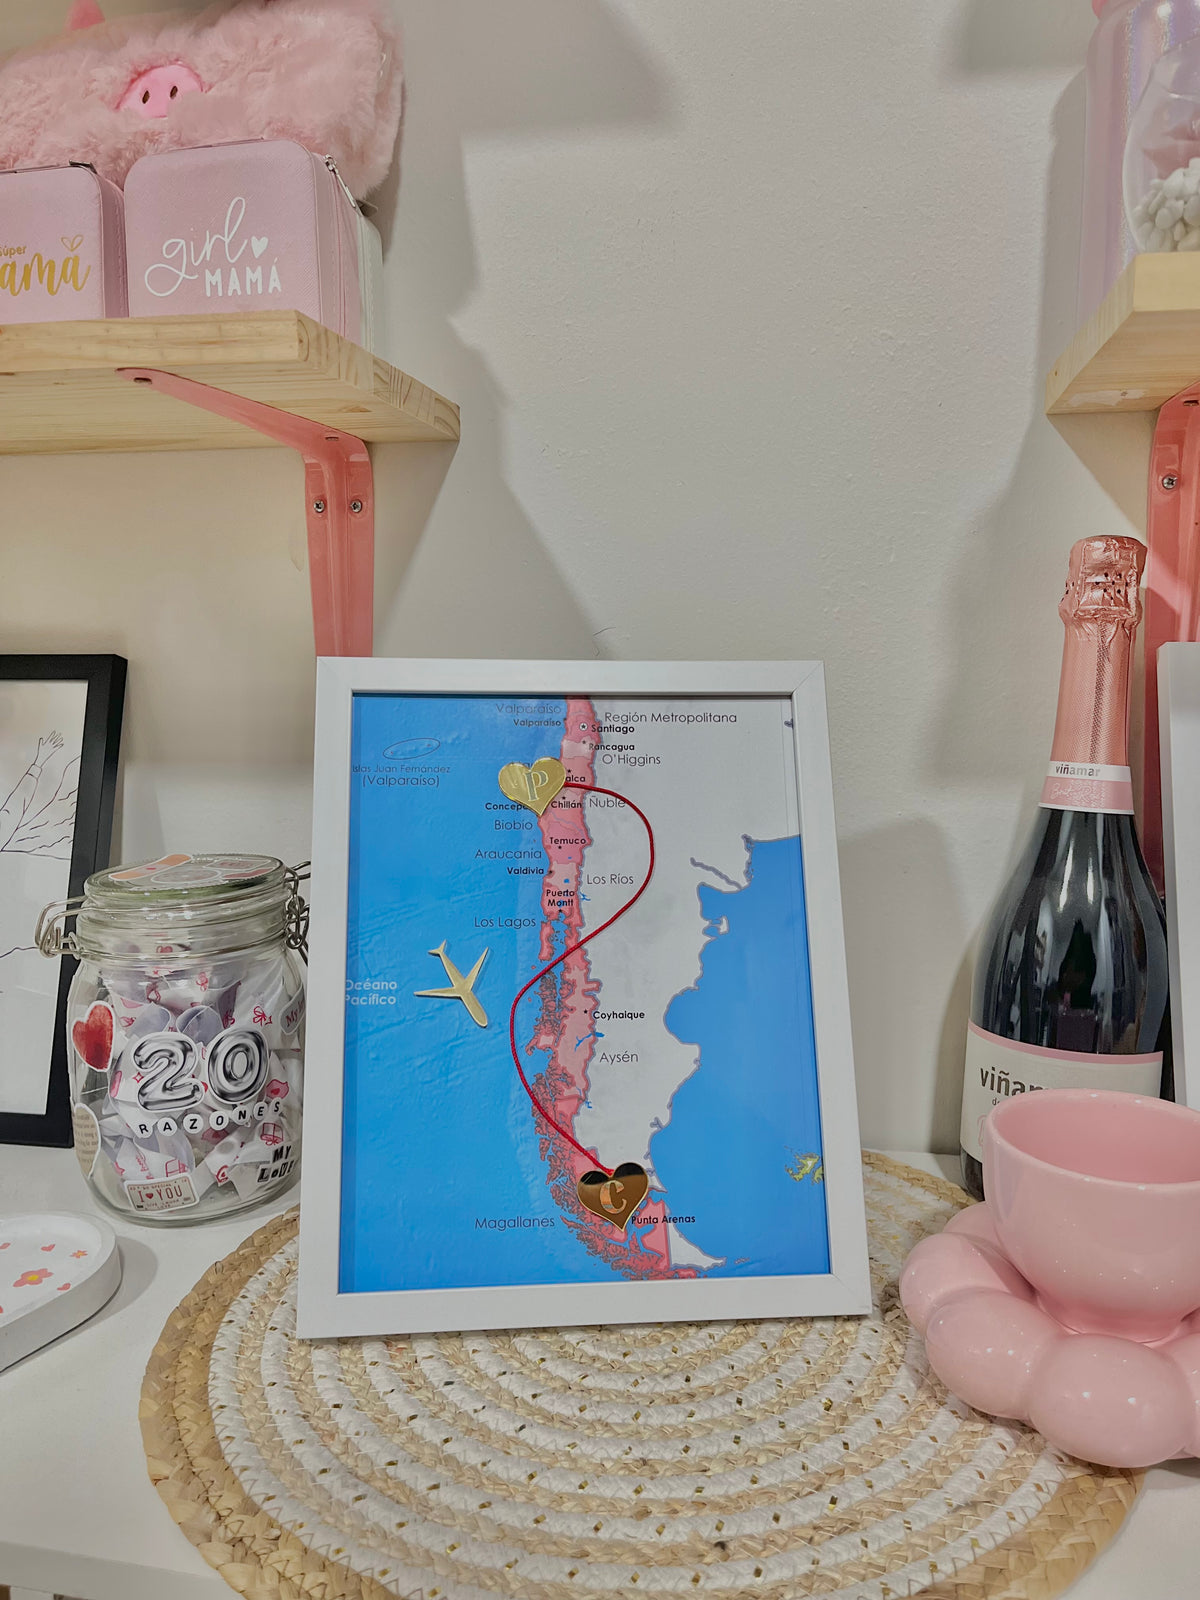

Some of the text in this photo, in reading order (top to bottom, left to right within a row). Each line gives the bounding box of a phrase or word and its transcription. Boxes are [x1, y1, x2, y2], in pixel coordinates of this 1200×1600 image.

[145, 197, 249, 297] girl
[204, 257, 283, 298] MAMÁ
[495, 703, 562, 716] Valparaíso
[513, 718, 562, 728] Valparaíso
[604, 711, 738, 726] Región Metropolitana
[591, 724, 635, 735] Santiago
[588, 743, 635, 753] Rancagua
[601, 753, 662, 767] O'Higgins
[374, 764, 398, 773] Juan
[1055, 763, 1102, 778] viñamar
[362, 774, 440, 788] (Valparaíso)
[565, 774, 586, 783] alca
[523, 770, 549, 801] P
[550, 799, 583, 809] Chillán
[589, 795, 626, 808] Ñuble
[494, 819, 533, 831] Biobío
[549, 836, 587, 845] Temuco
[474, 848, 542, 860] Araucanía
[506, 866, 545, 875] Valdivia
[587, 872, 634, 885] Los Ríos
[546, 889, 575, 897] Puerto
[547, 899, 574, 907] Montt
[474, 916, 537, 930] Los Lagos
[345, 977, 398, 991] Océano
[592, 1010, 646, 1021] Coyhaique
[599, 1050, 639, 1065] Aysén
[133, 1029, 270, 1112] 20
[138, 1100, 281, 1135] RAZONES
[272, 1145, 292, 1163] MY
[156, 1184, 183, 1201] YOU
[599, 1179, 628, 1214] C
[474, 1214, 556, 1231] Magallanes
[631, 1214, 696, 1225] Punta Arenas
